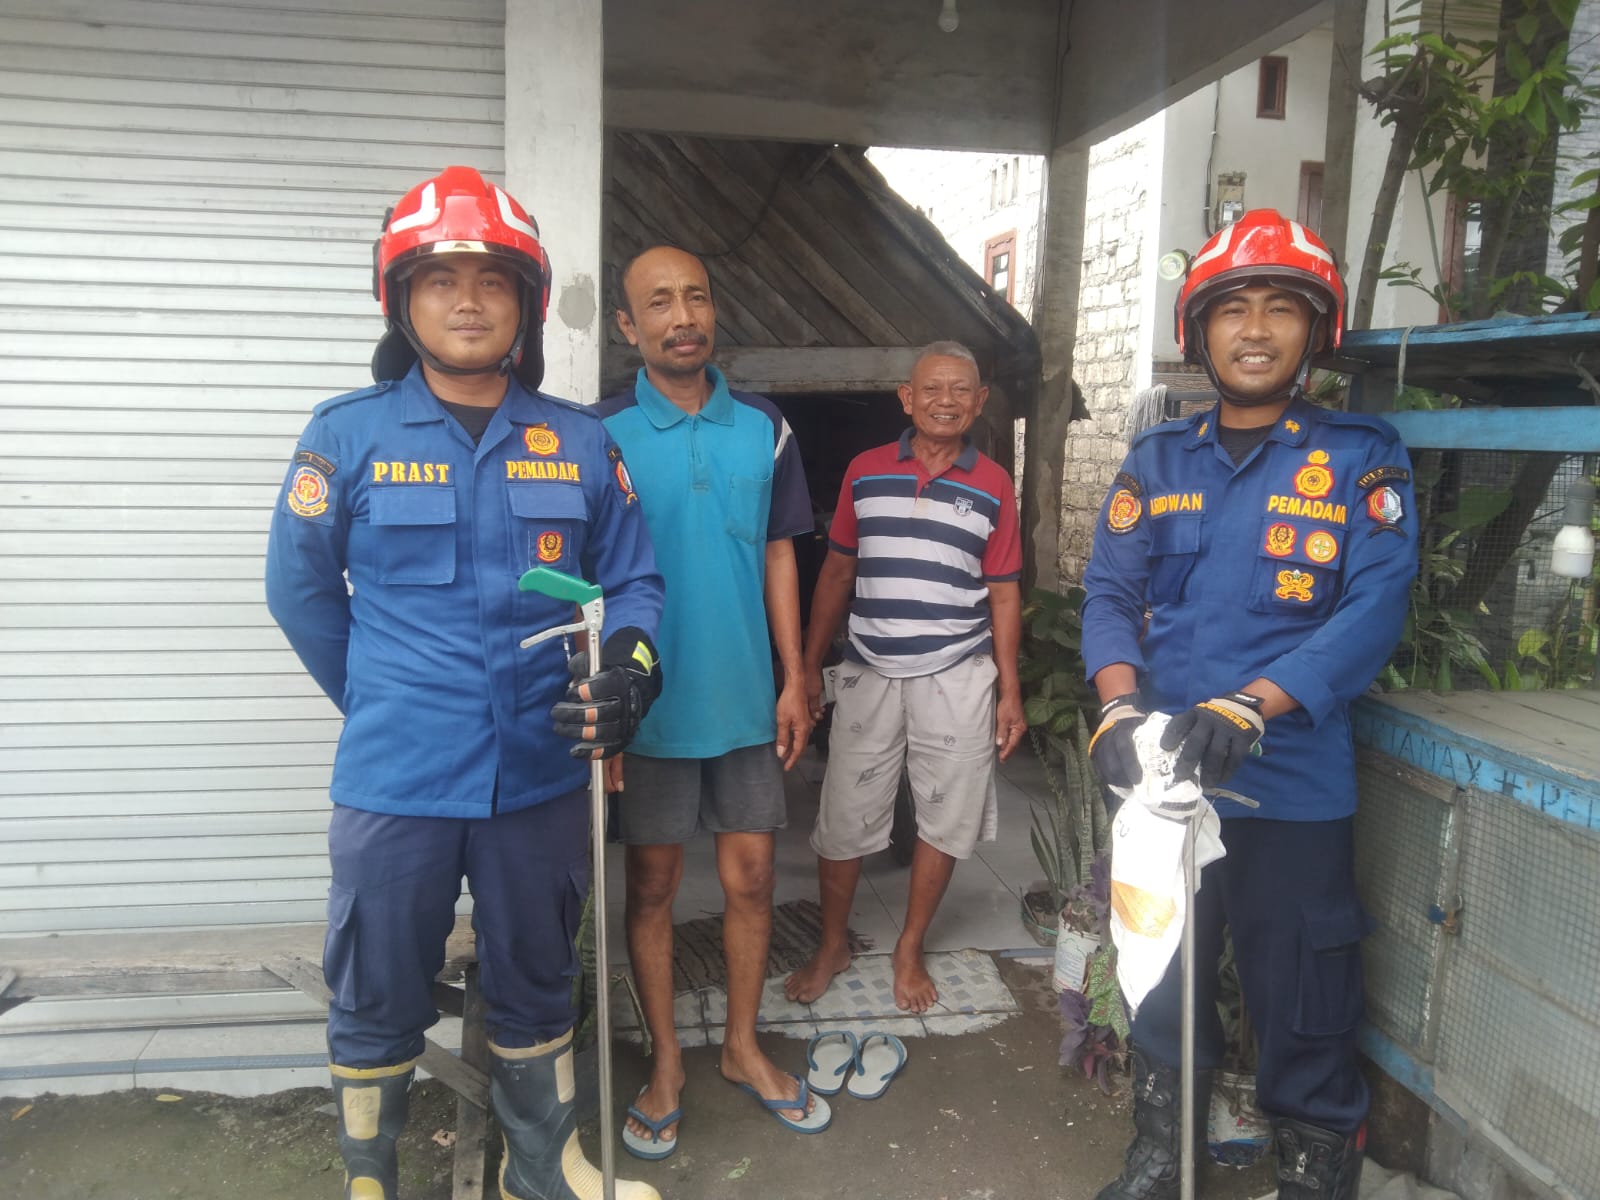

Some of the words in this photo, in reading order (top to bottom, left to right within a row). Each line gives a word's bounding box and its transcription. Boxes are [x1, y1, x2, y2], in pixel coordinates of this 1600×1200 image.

[372, 462, 450, 483] PRAST
[506, 460, 580, 482] PEMADAM
[1267, 495, 1346, 524] PEMADAM
